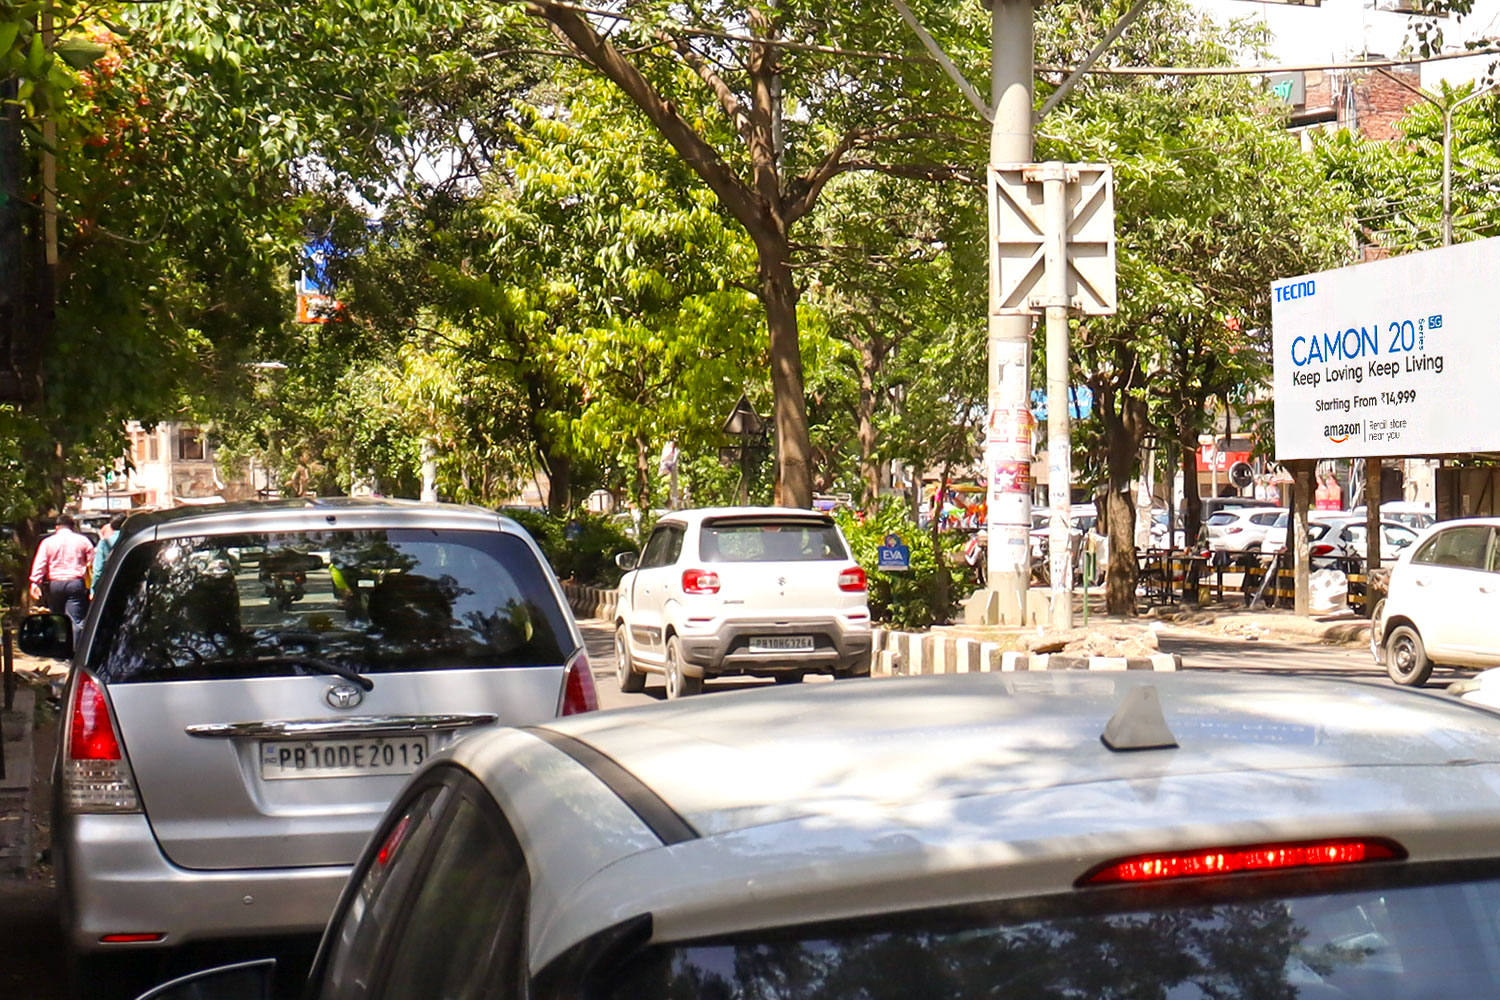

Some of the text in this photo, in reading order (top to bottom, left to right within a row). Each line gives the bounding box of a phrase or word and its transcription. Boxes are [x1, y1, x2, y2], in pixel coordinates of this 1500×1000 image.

[1274, 280, 1316, 302] TECNO
[1429, 315, 1442, 329] 5G
[1291, 320, 1415, 366] CAMON 20
[1418, 317, 1426, 351] Series
[1292, 354, 1444, 388] Keep Loving Keep Living
[1315, 389, 1416, 413] Starting From ₹14,999
[1323, 418, 1407, 438] amazon Retail store
[1368, 431, 1400, 442] near you
[883, 550, 903, 560] EVA
[279, 743, 424, 771] PB10DE2013
